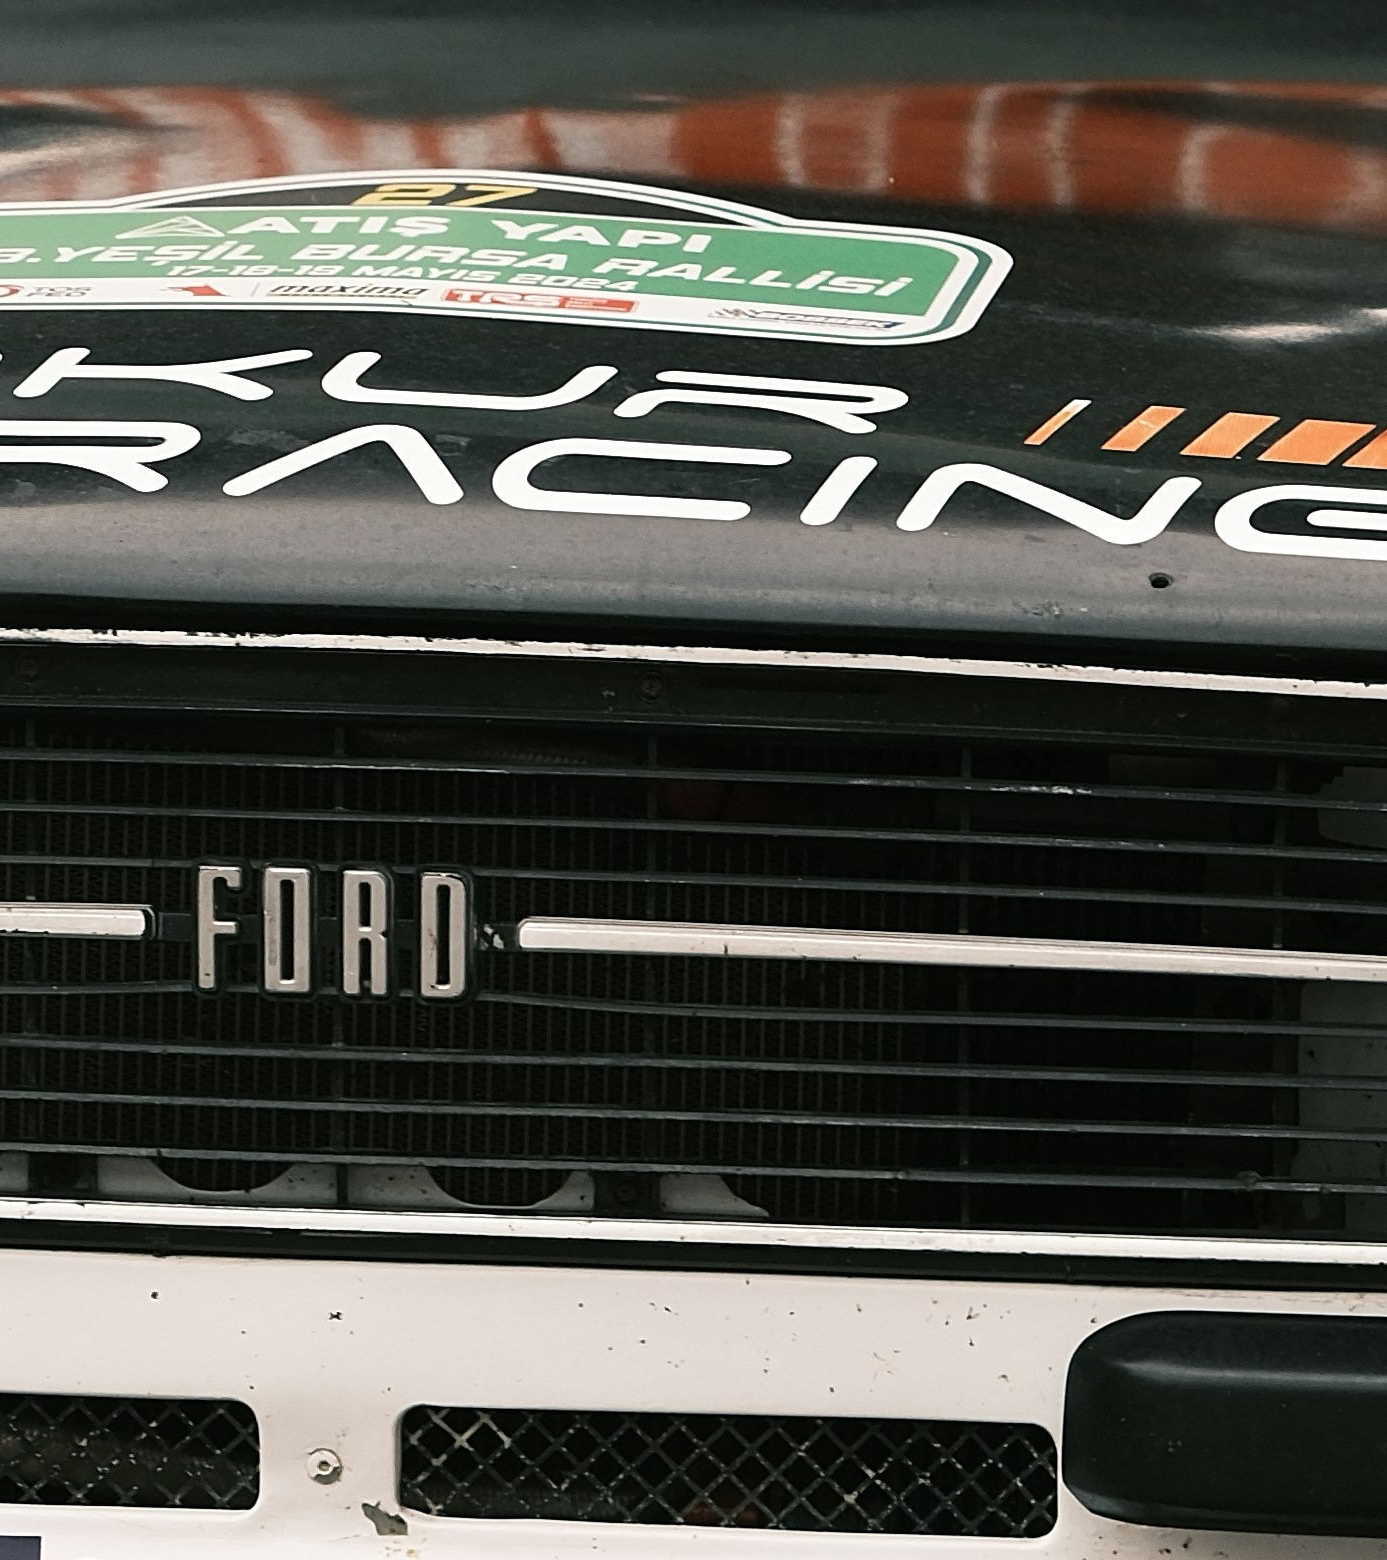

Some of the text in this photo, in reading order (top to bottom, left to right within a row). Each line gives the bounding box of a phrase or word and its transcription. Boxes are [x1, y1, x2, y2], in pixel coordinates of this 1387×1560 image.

[349, 183, 538, 206] 27
[228, 215, 712, 253] ATIŞ YAPI
[291, 243, 568, 271] BURSA
[593, 257, 912, 297] RALLİSİ
[352, 266, 501, 282] MAYIS
[522, 273, 637, 290] 2024
[270, 282, 428, 296] maxima
[451, 290, 562, 307] TRS
[197, 866, 466, 998] FORD
